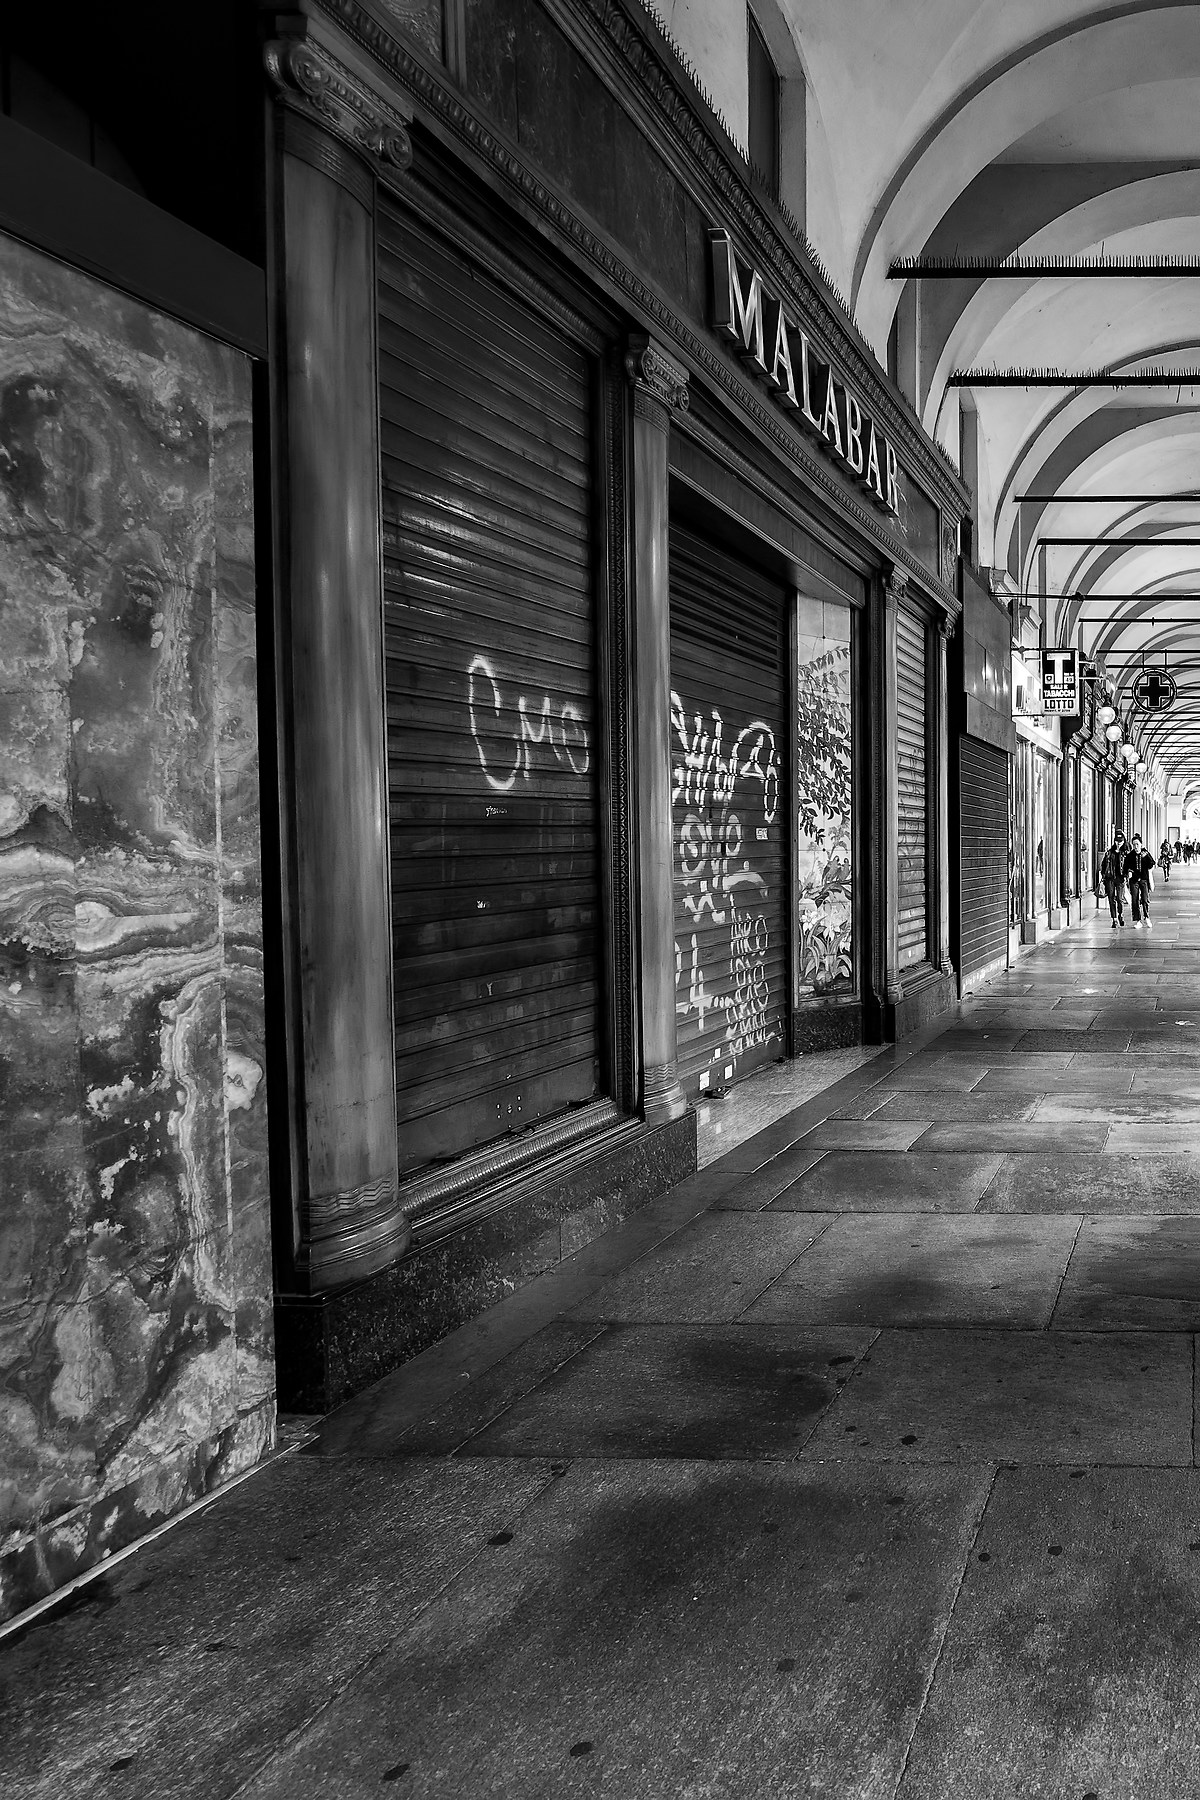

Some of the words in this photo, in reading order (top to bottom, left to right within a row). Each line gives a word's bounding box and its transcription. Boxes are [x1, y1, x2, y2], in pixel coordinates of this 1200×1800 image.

[710, 228, 899, 517] MALABAR
[1047, 652, 1071, 684] T
[1045, 700, 1074, 709] LOTTO
